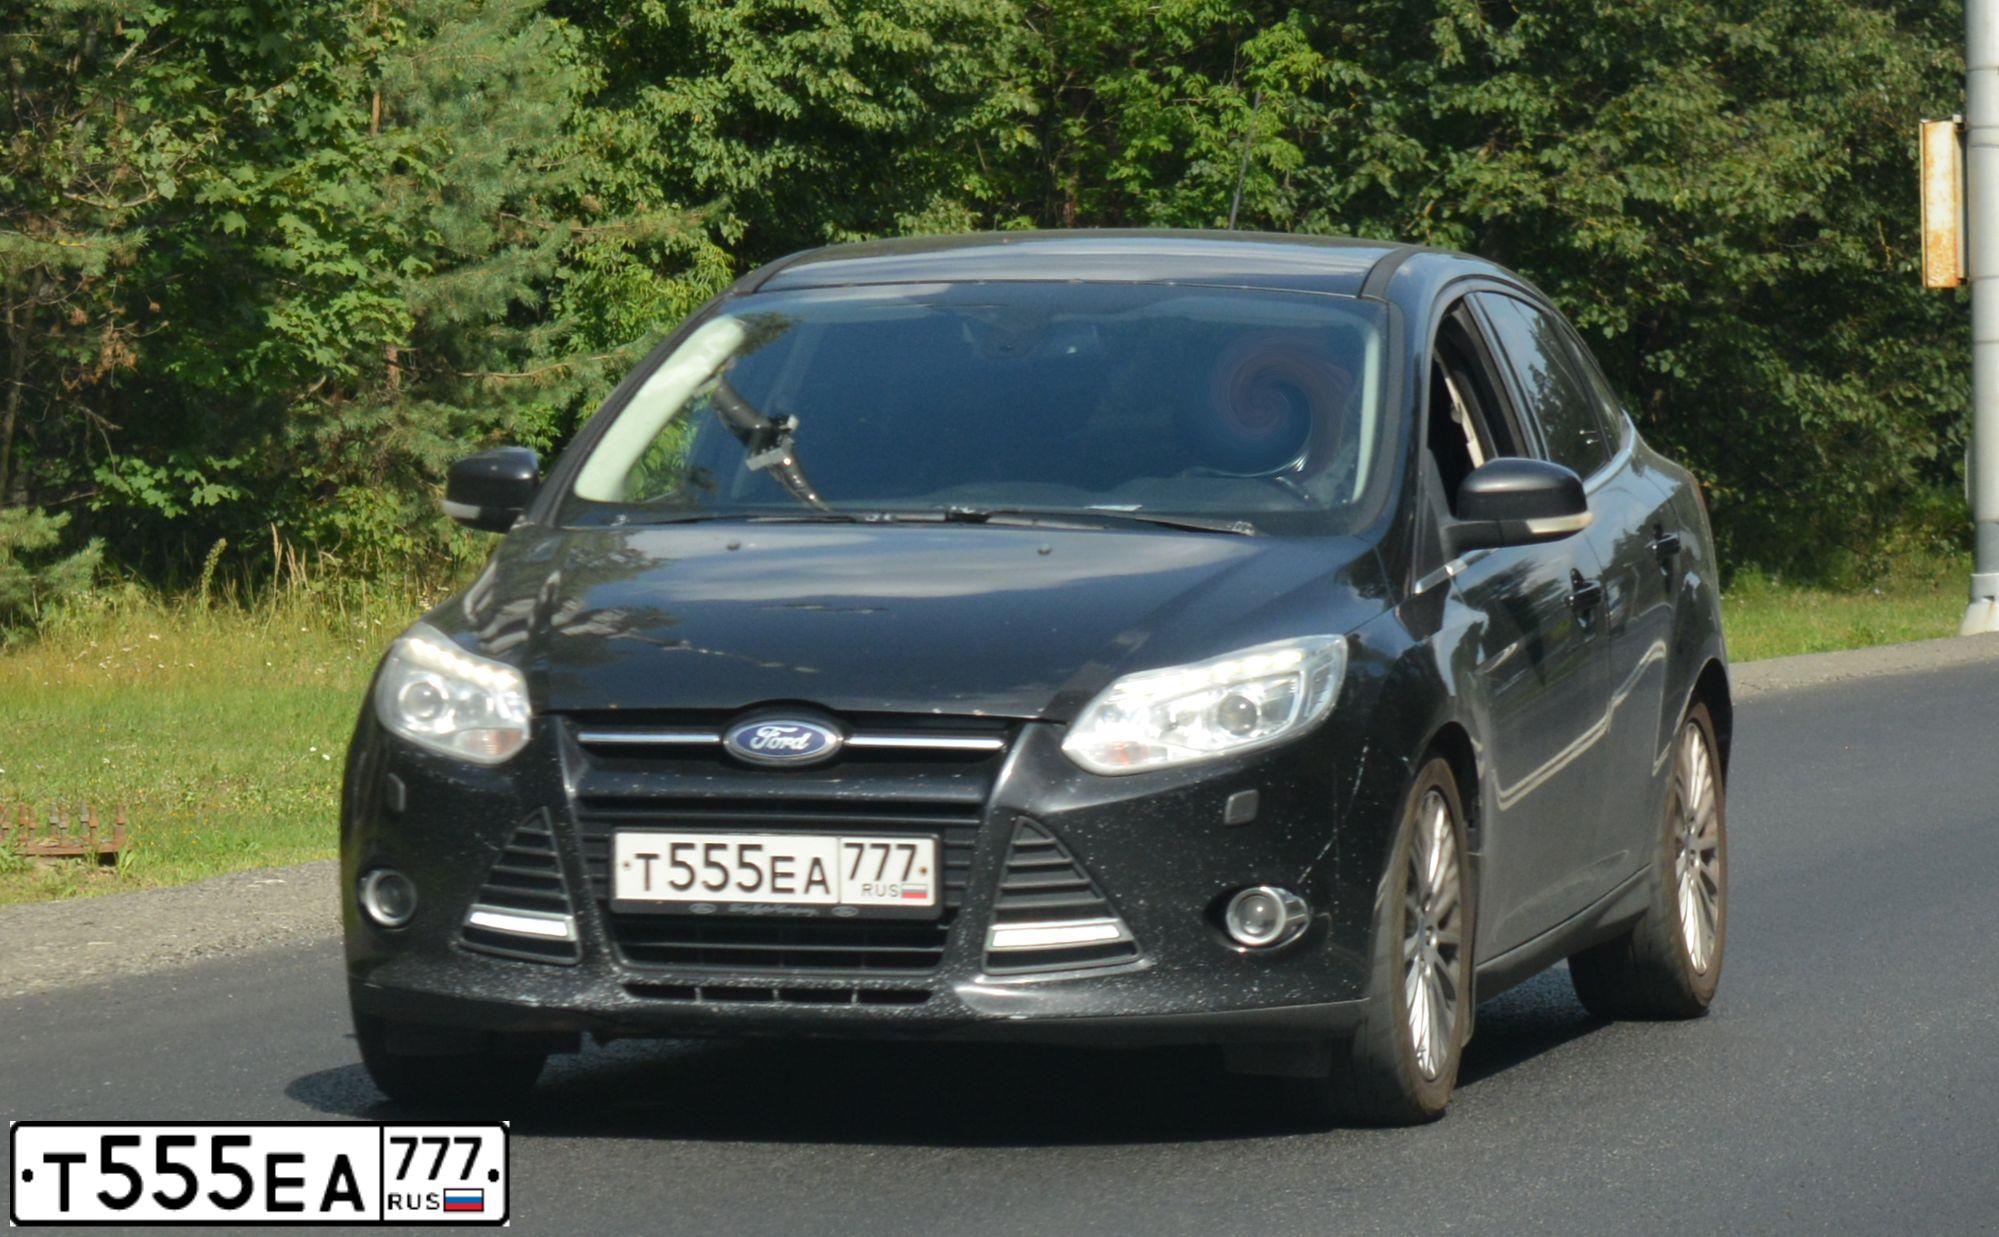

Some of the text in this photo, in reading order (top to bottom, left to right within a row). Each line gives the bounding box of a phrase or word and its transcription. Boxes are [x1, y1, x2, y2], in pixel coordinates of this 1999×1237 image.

[750, 725, 813, 750] Ford
[635, 842, 917, 895] T555EA 777
[861, 882, 900, 898] RUS
